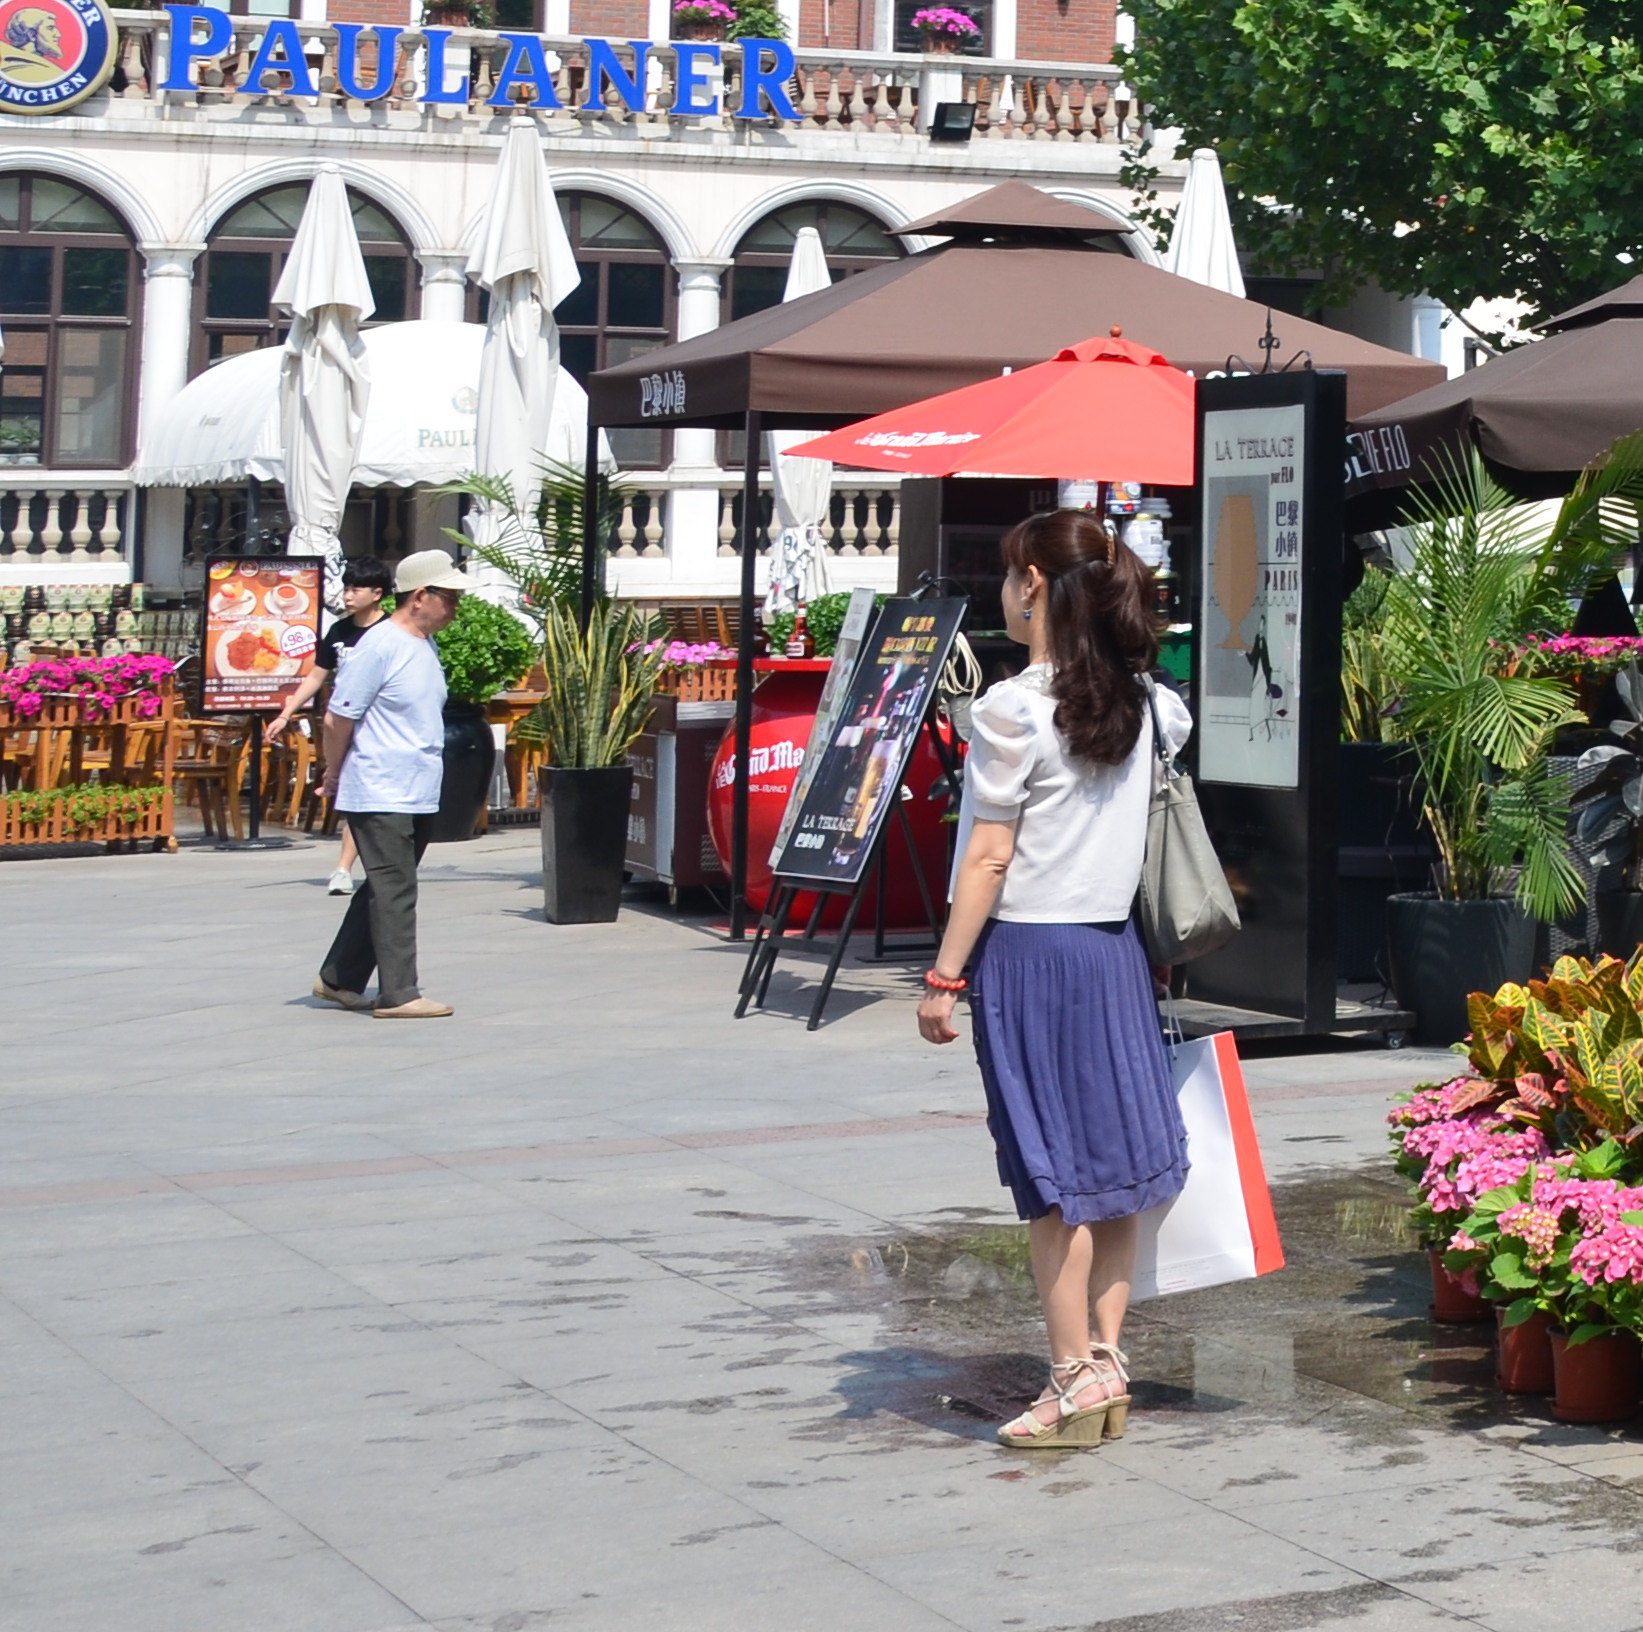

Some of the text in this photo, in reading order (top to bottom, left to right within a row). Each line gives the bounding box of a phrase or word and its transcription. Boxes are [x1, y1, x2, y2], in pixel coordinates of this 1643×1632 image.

[159, 3, 804, 120] PAULANER
[640, 370, 687, 417] 巴黎小镇
[1215, 436, 1295, 461] LA TERRACE
[1379, 424, 1411, 472] FLO
[1281, 466, 1294, 484] FLO
[1276, 500, 1298, 526] 巴黎
[1275, 531, 1298, 557] 小镇
[1264, 570, 1298, 591] PARIS
